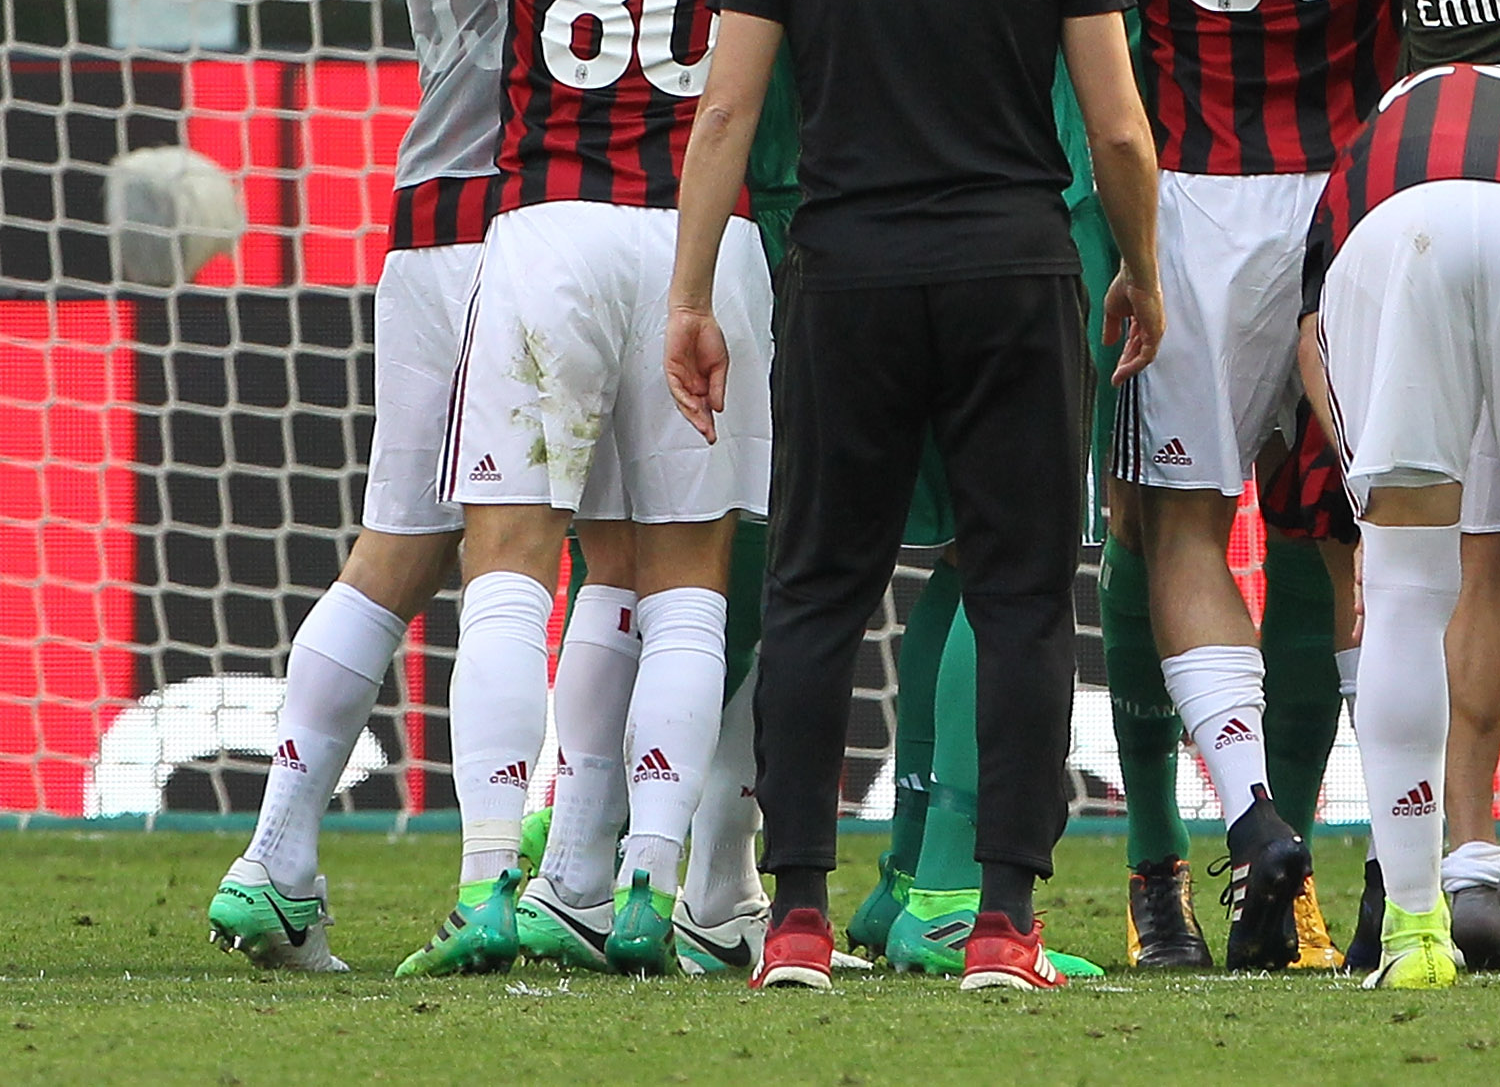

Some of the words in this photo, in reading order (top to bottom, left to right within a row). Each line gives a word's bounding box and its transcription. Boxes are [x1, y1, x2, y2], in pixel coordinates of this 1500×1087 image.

[1153, 454, 1192, 466] adidas
[469, 470, 502, 482] adidas
[1214, 732, 1260, 751] adidas
[489, 774, 529, 791] adida
[633, 768, 681, 783] adidas
[1392, 800, 1437, 817] adidas
